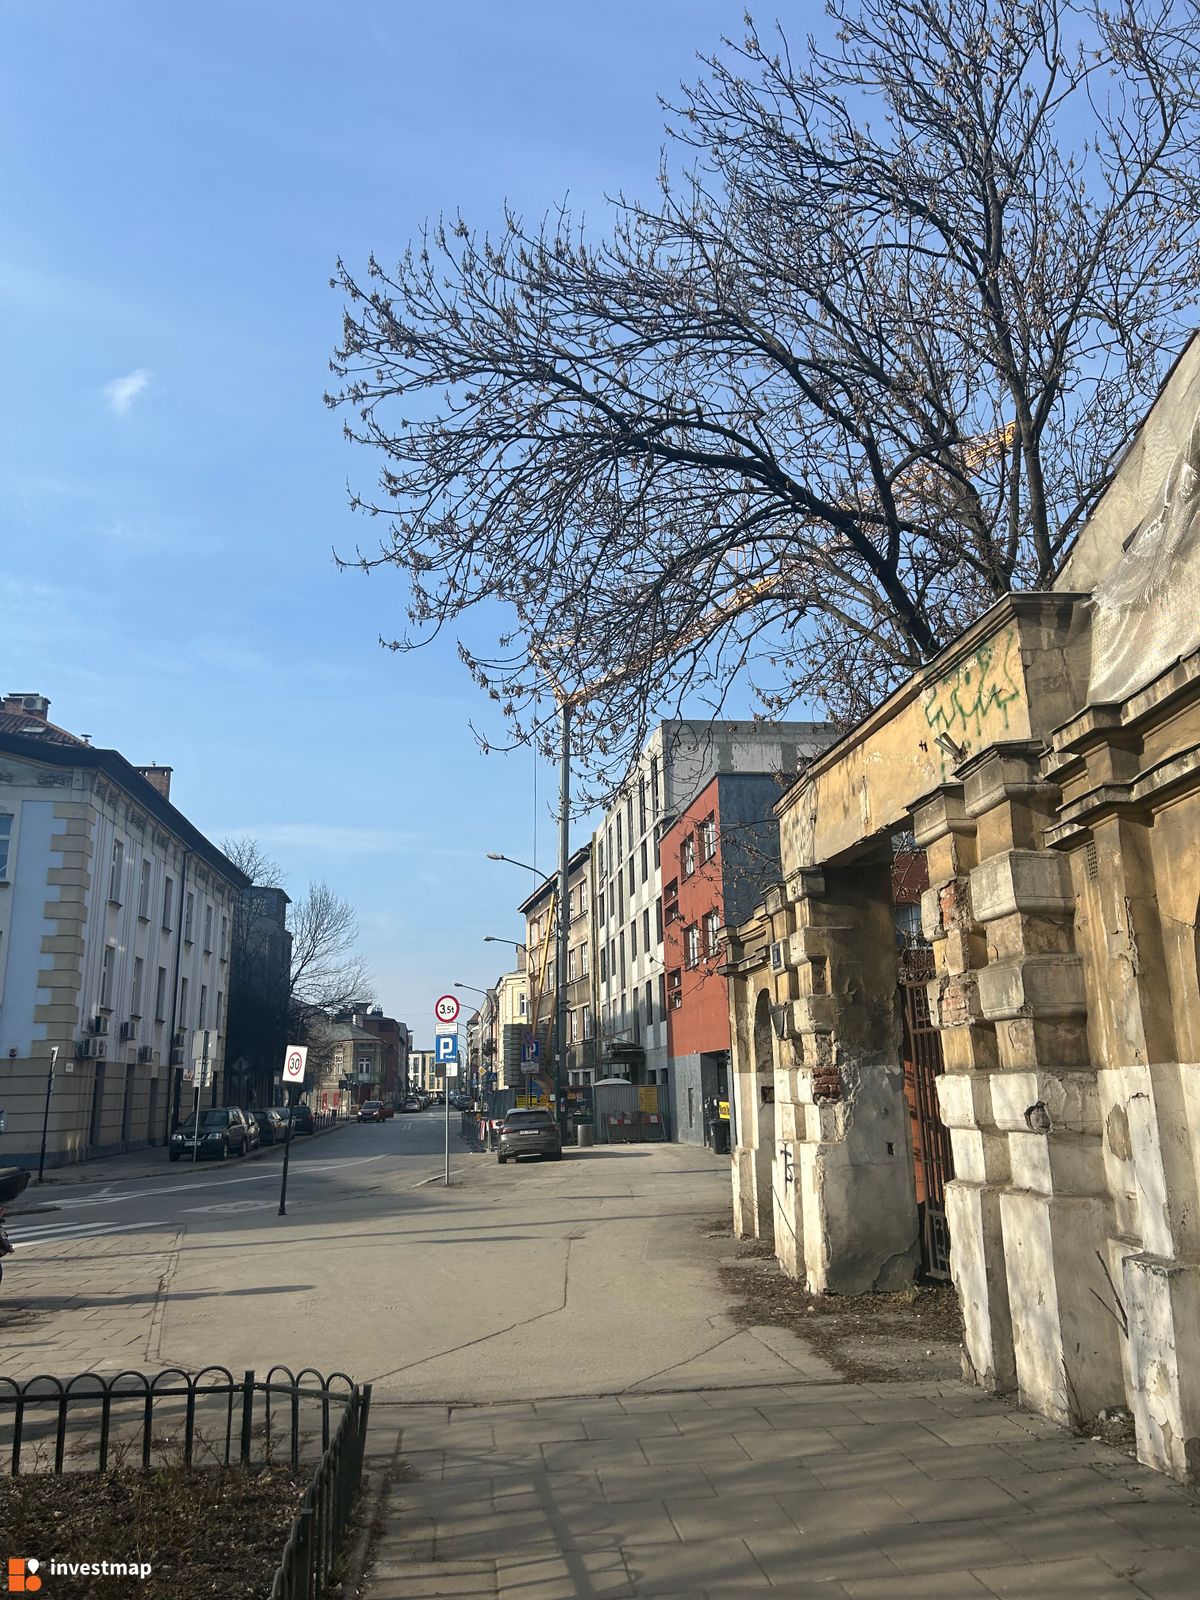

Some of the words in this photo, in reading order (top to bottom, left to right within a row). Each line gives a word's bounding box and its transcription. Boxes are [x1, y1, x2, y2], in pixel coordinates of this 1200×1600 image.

[440, 1004, 454, 1015] 3,5t
[440, 1037, 453, 1060] P
[290, 1058, 300, 1070] 30
